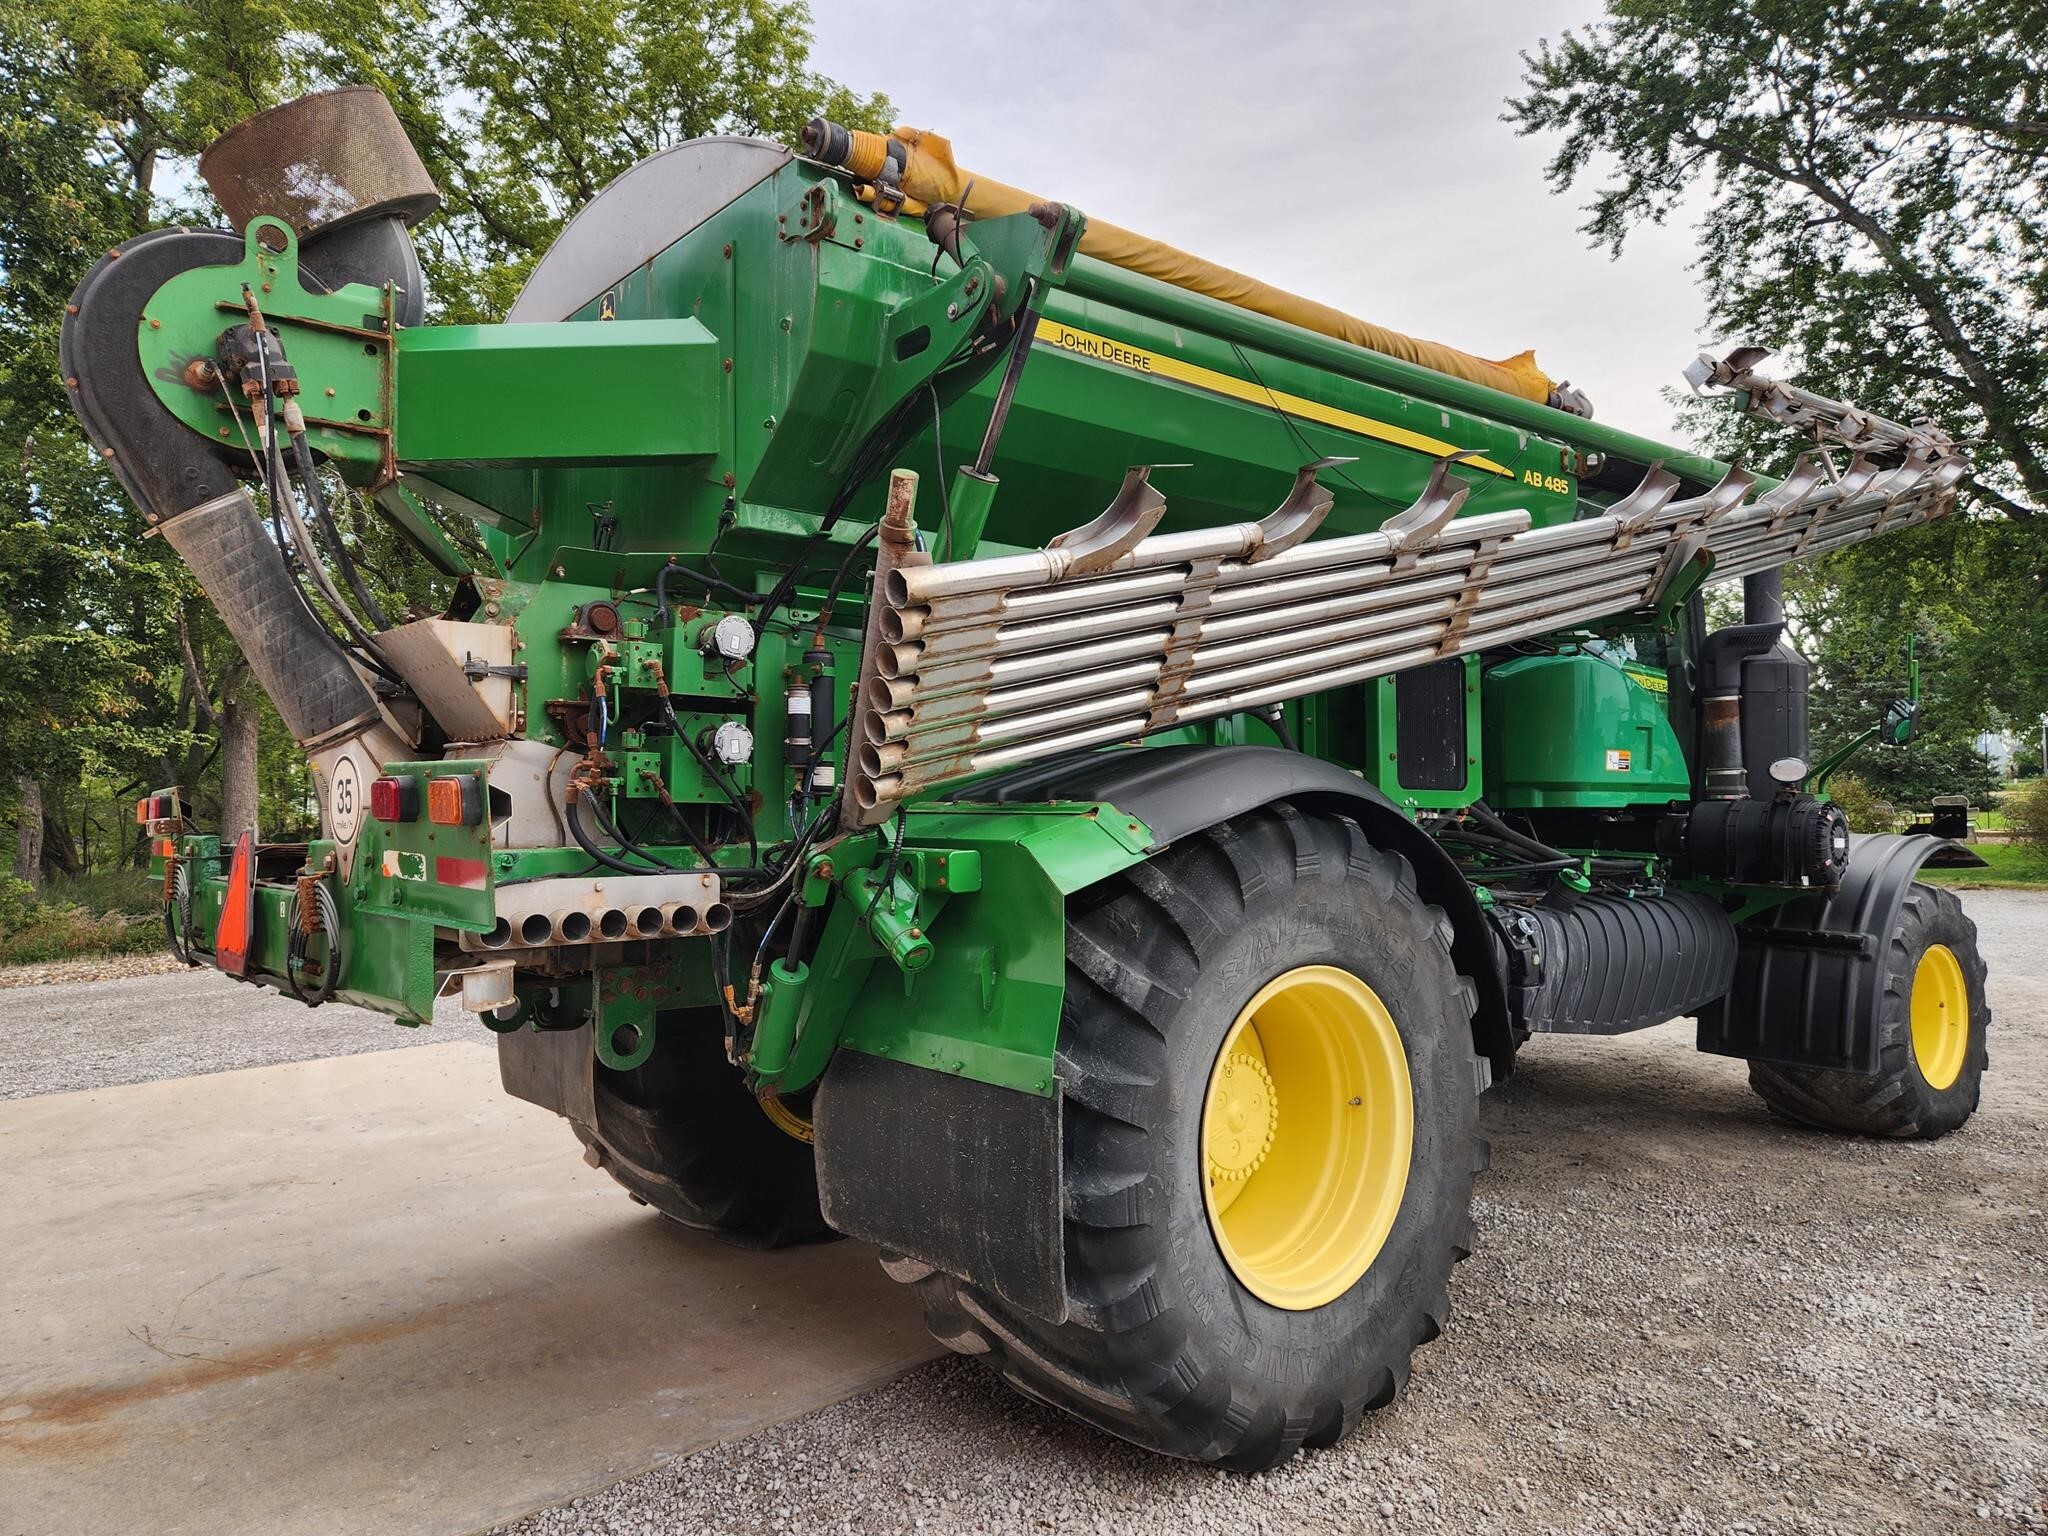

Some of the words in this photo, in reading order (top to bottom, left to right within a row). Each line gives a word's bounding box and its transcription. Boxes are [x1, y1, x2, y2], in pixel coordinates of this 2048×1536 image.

[1055, 328, 1098, 355] JOHN
[1102, 341, 1151, 370] DEERE
[1523, 469, 1543, 488] AB
[1544, 475, 1569, 495] 485
[1646, 678, 1668, 691] DEER
[337, 778, 352, 814] 35
